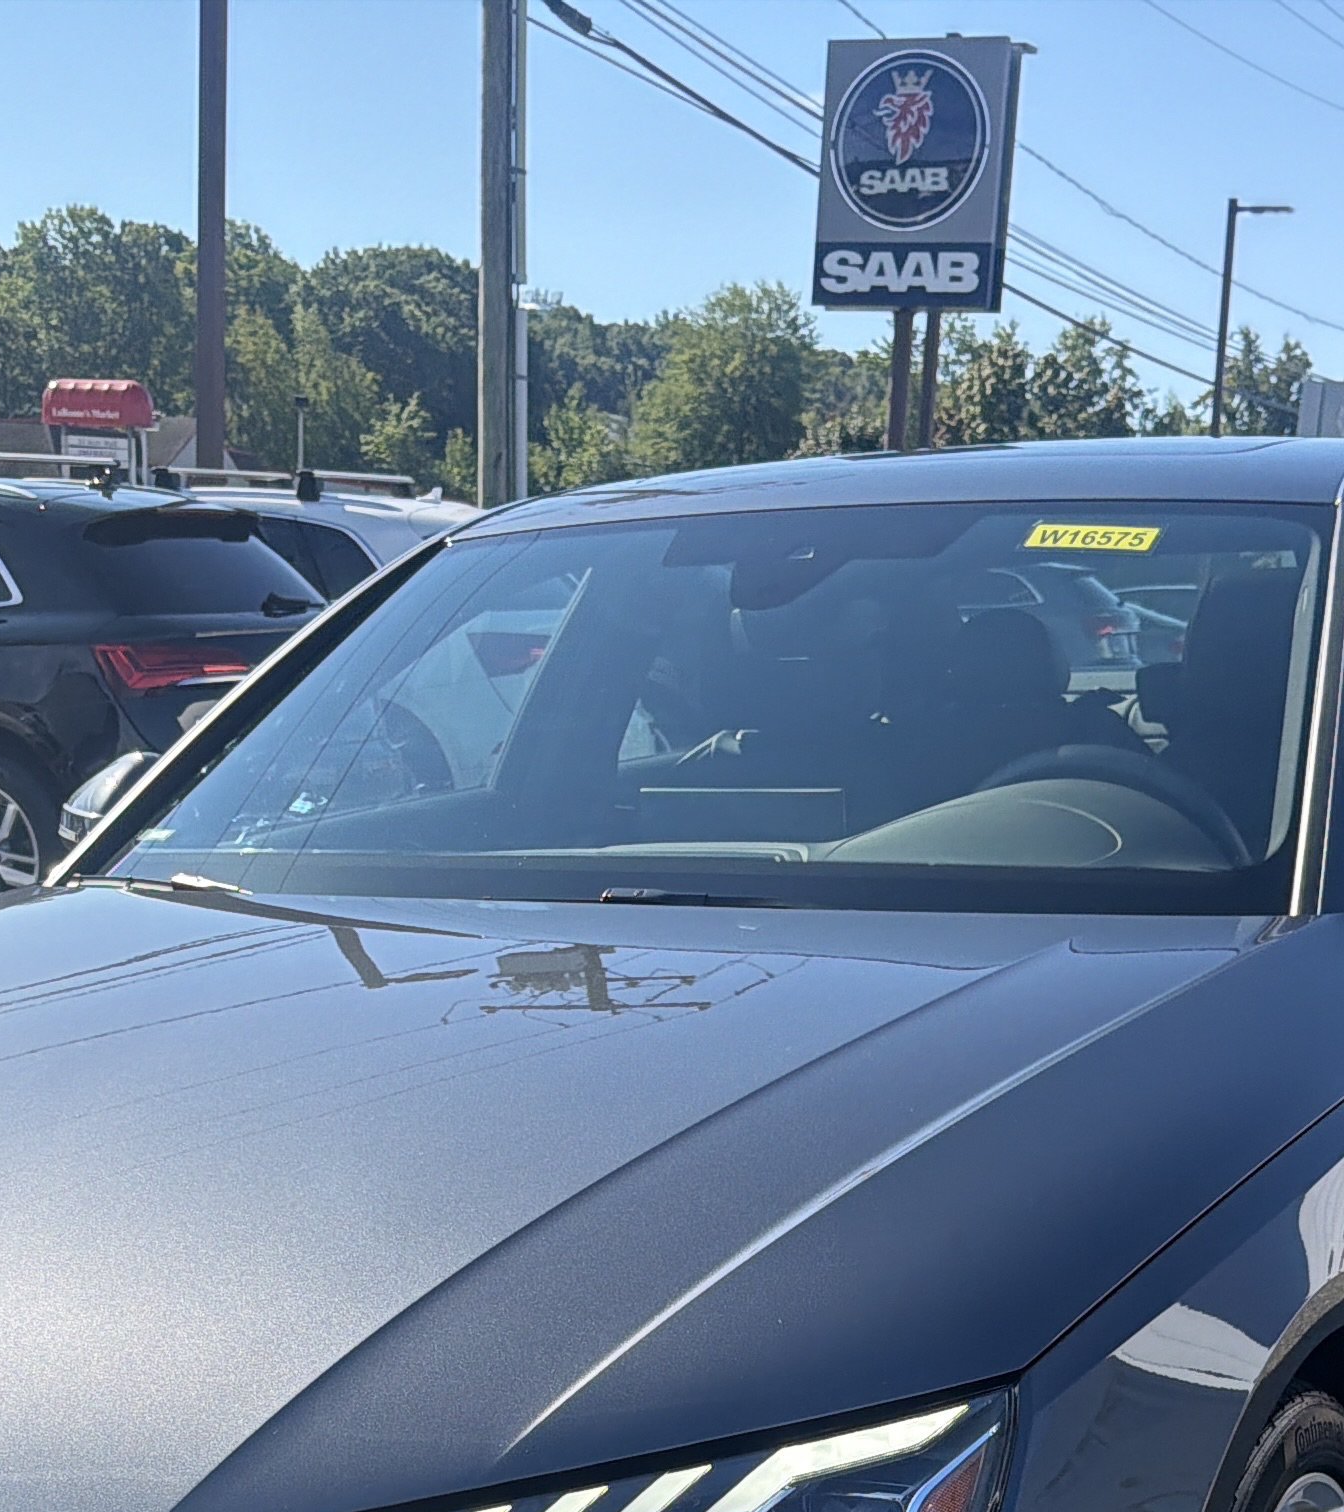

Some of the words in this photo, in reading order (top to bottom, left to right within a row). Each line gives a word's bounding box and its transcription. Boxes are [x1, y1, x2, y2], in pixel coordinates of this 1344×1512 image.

[859, 167, 949, 196] SAAB
[820, 249, 980, 294] SAAB
[1038, 529, 1147, 547] W16575
